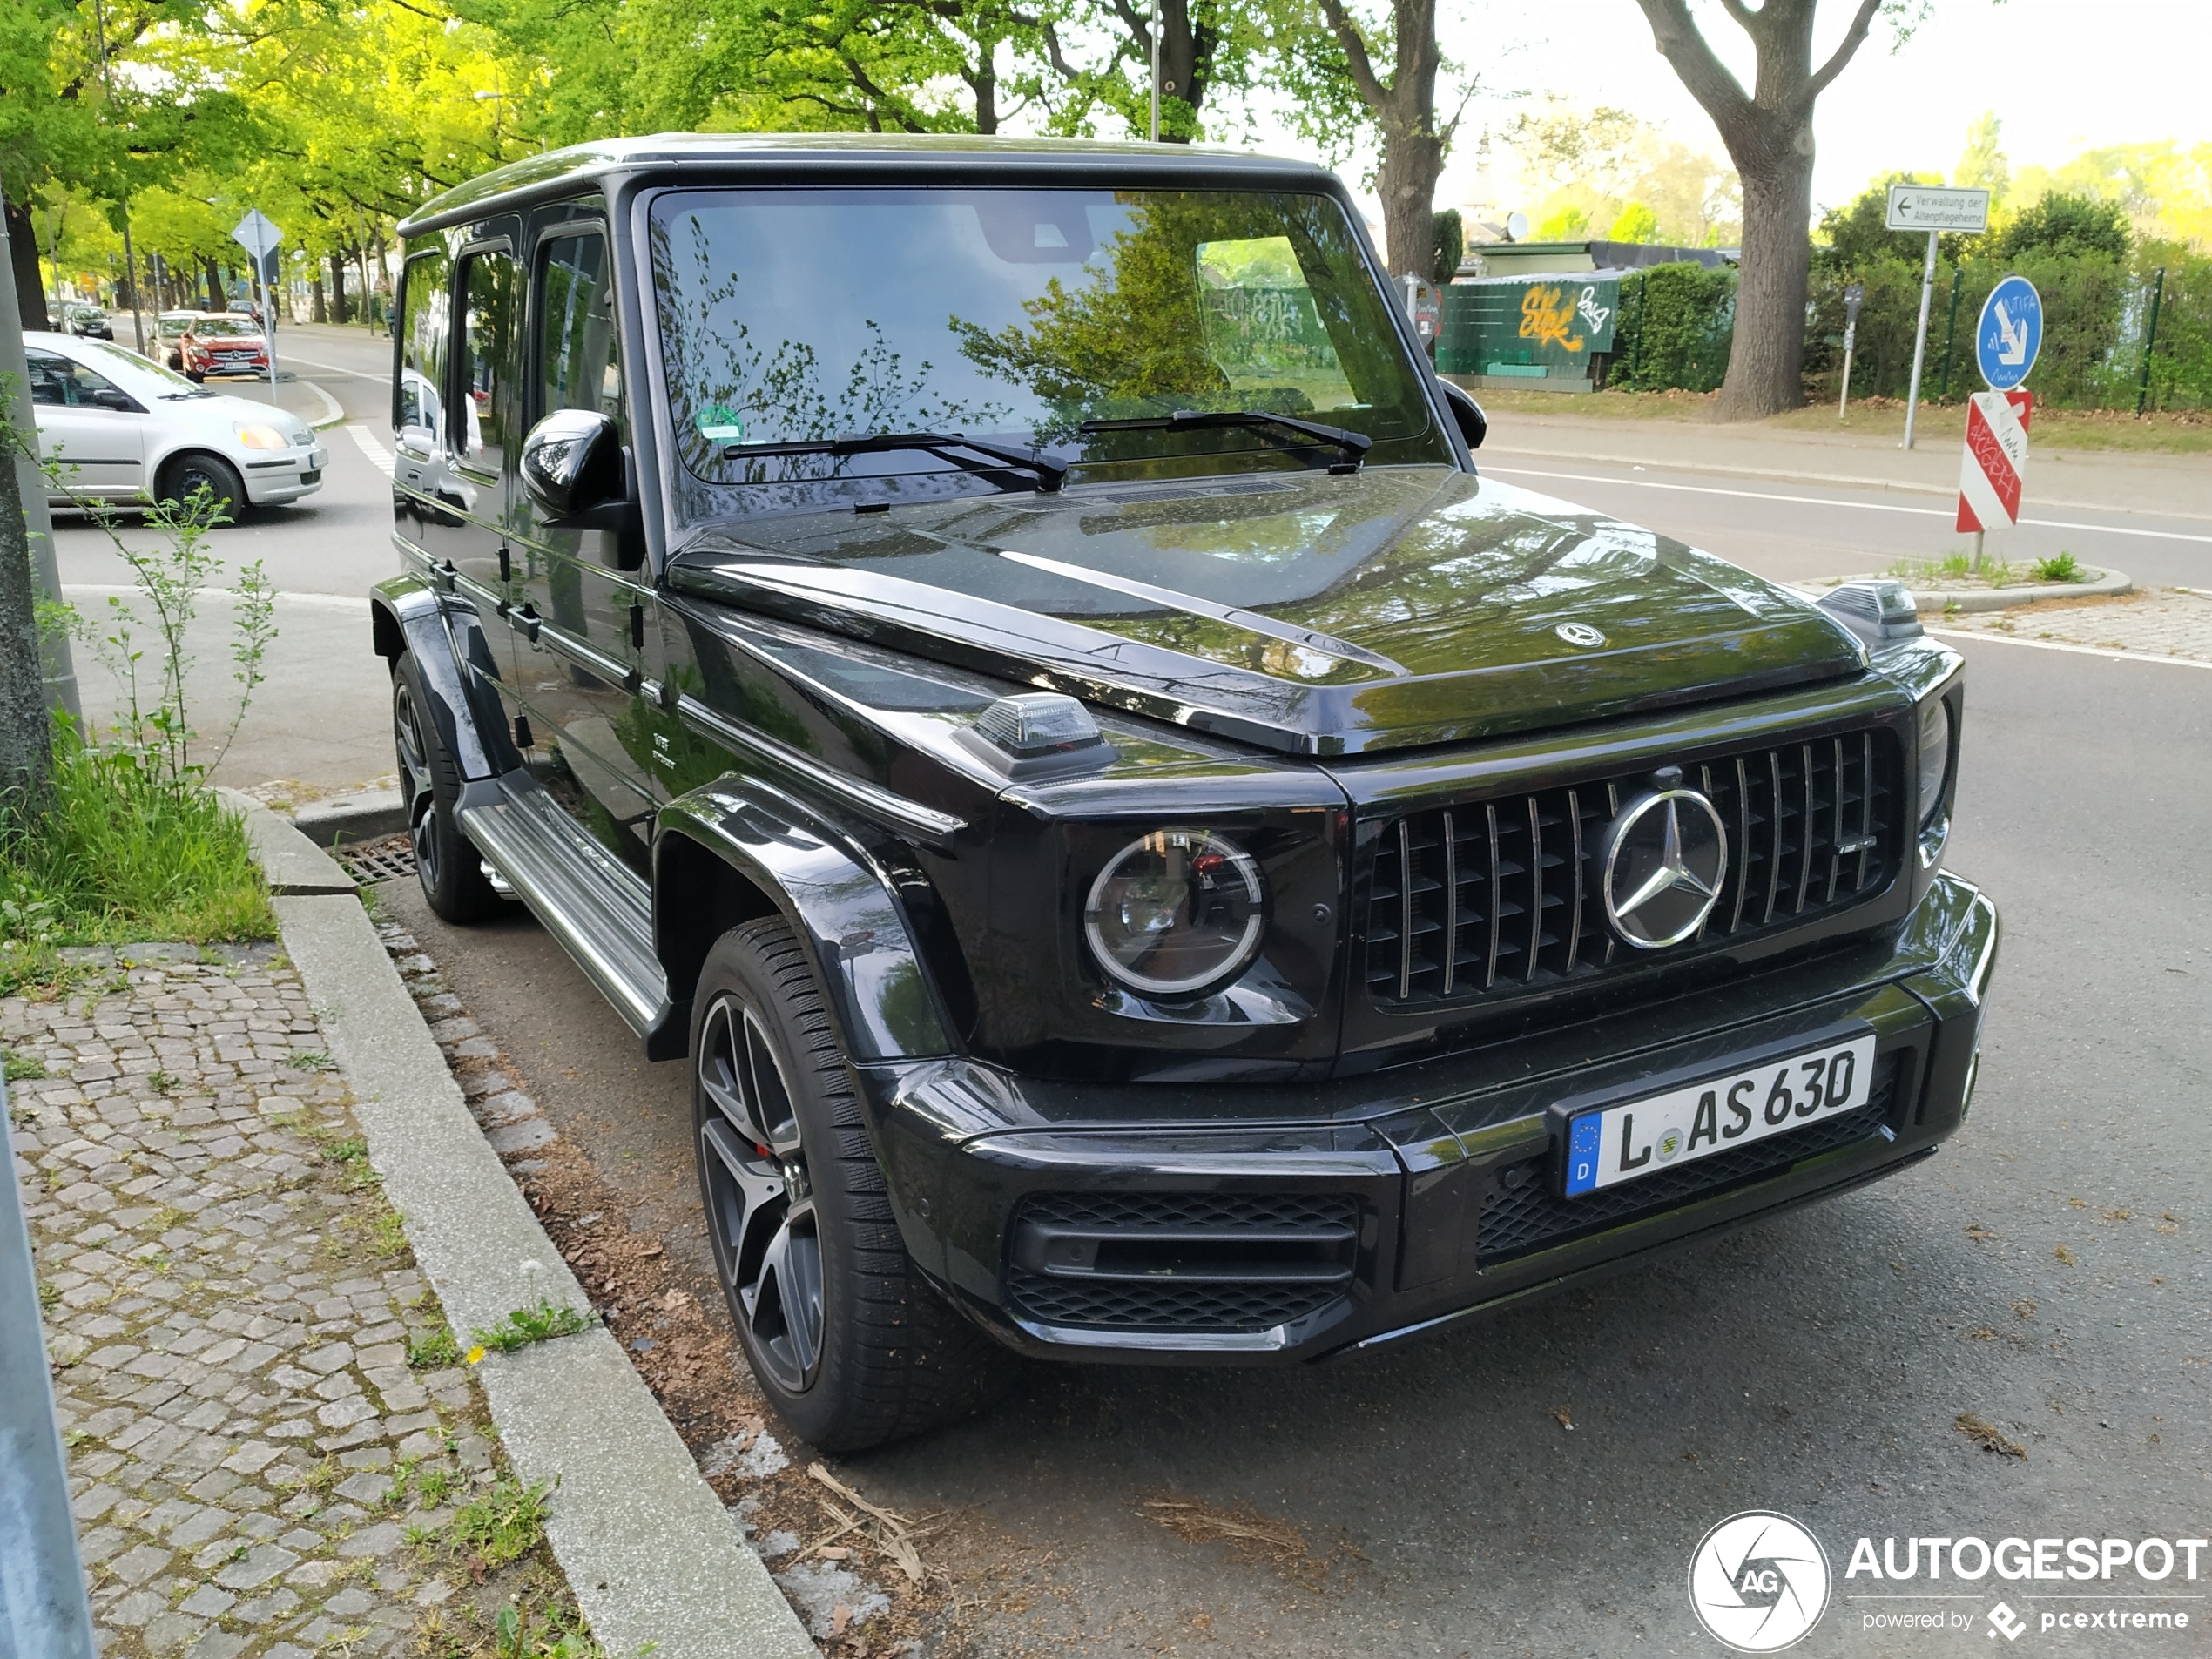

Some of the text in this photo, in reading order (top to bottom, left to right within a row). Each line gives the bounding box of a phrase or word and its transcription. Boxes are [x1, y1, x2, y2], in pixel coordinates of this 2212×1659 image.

[1916, 194, 1983, 210] Verwaltung der
[1913, 211, 1983, 226] Altenpflegeheime
[1997, 295, 2037, 315] NTIFA
[1618, 1113, 1652, 1172] L
[1577, 1163, 1589, 1181] D
